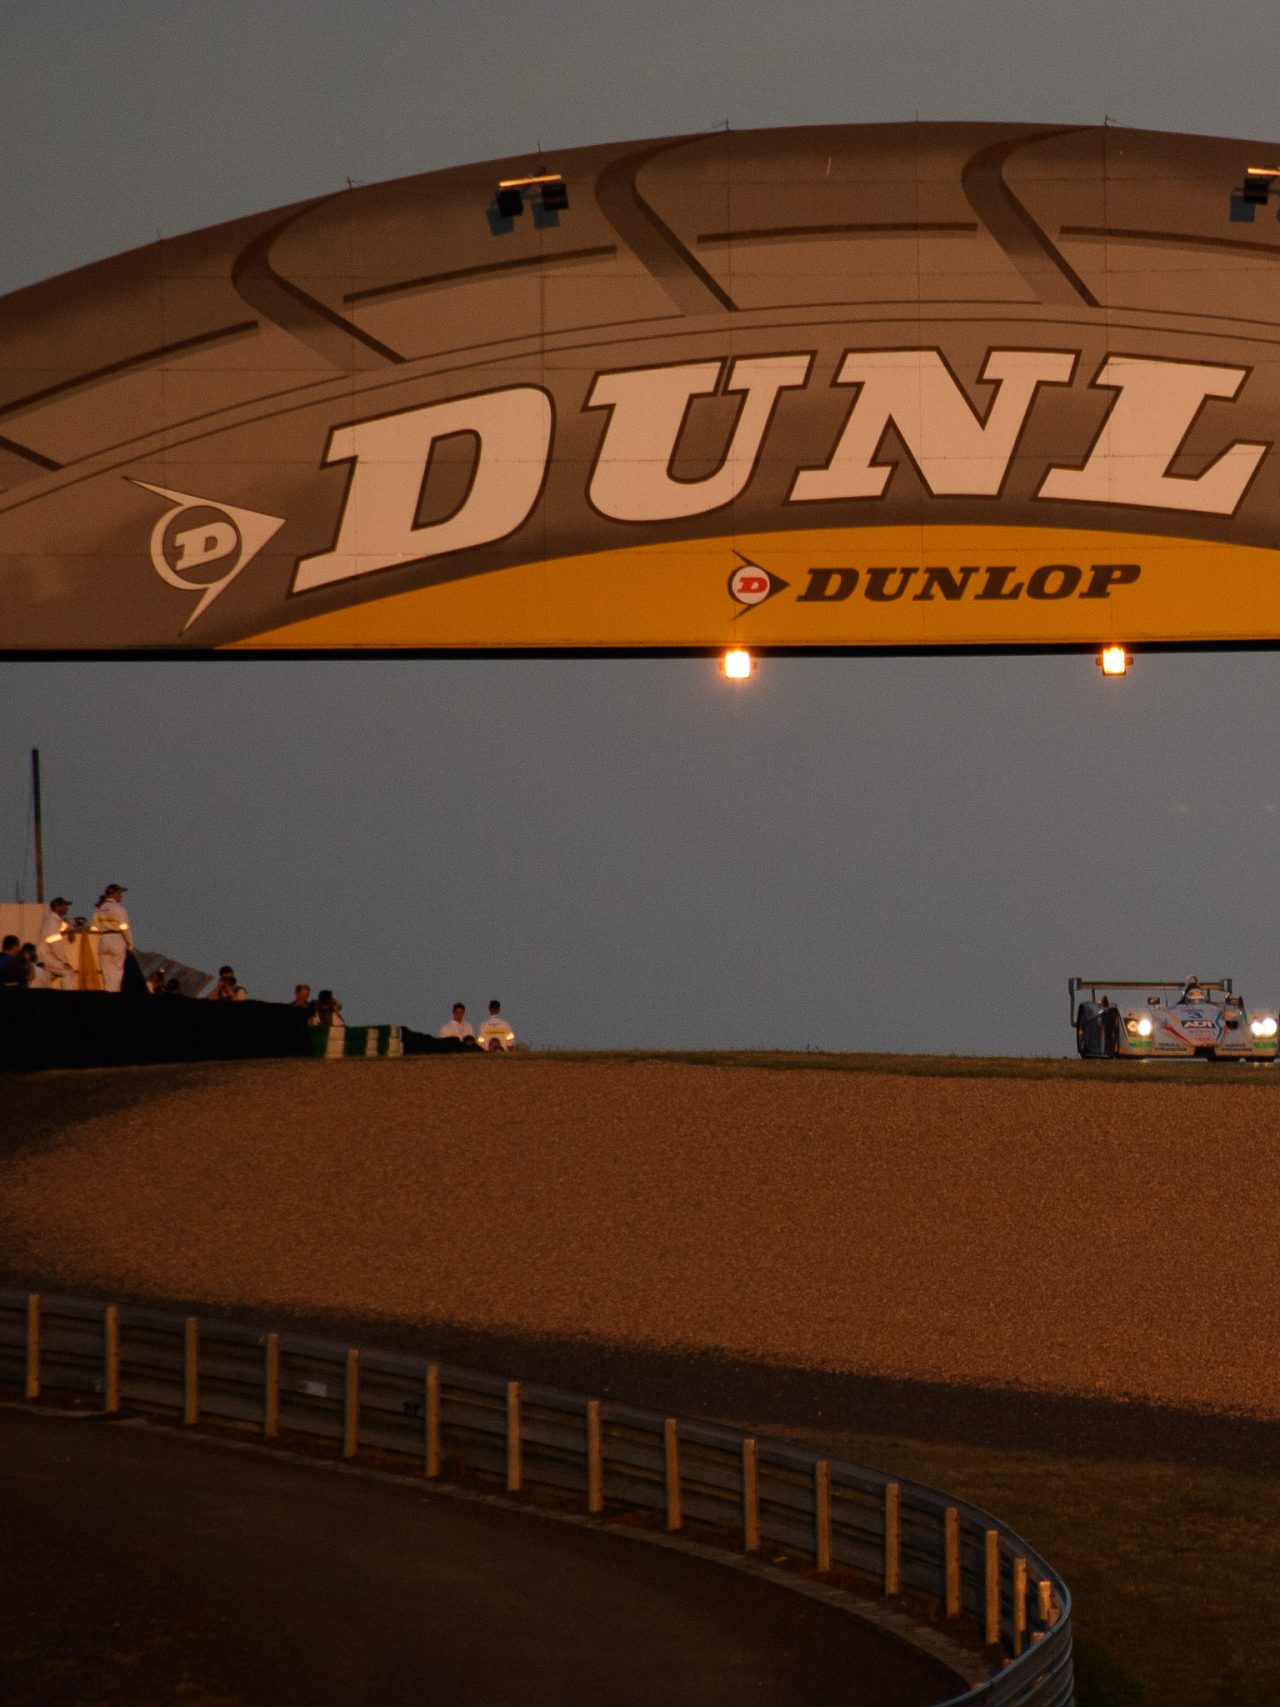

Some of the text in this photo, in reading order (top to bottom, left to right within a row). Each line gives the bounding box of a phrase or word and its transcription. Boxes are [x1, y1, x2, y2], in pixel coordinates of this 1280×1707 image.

[174, 521, 238, 571] D
[736, 564, 1141, 602] D DUNLOP
